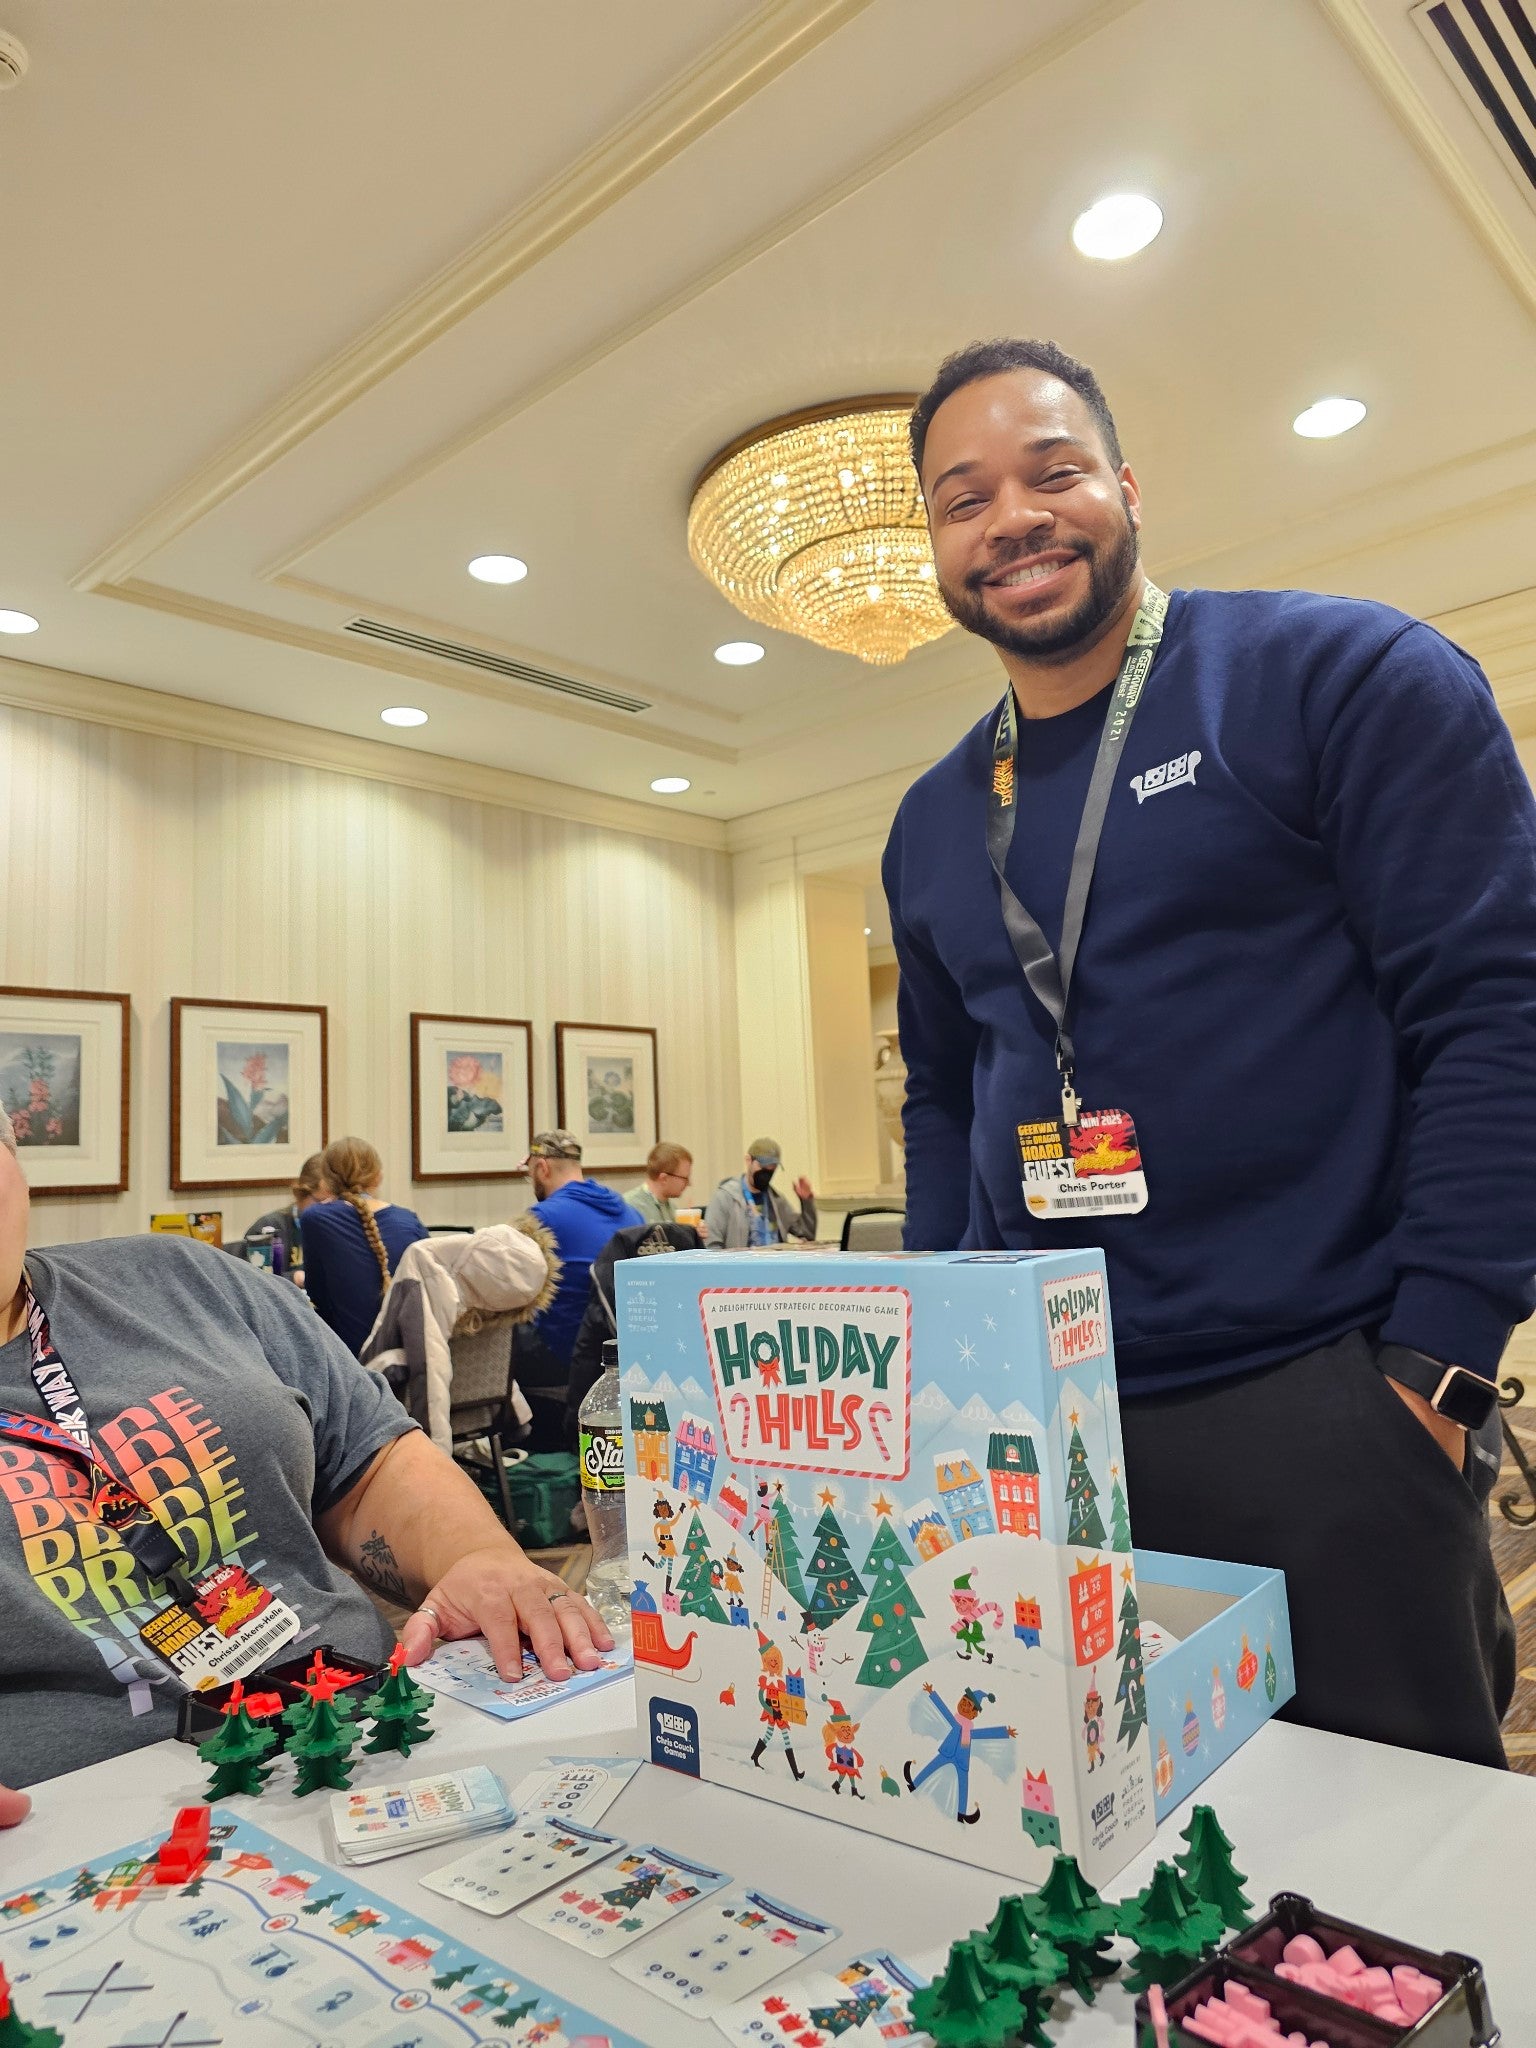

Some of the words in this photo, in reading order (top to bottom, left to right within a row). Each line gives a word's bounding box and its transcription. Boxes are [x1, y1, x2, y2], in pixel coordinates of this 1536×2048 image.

[1117, 673, 1132, 698] West
[1109, 710, 1127, 741] 2021
[1017, 1121, 1058, 1136] GEEKWAY
[1101, 1114, 1122, 1126] 2025
[1021, 1143, 1063, 1162] HOARD
[1024, 1158, 1076, 1181] GUEST
[1060, 1182, 1087, 1193] Chris
[1090, 1180, 1127, 1191] Porter
[711, 1305, 718, 1313] A
[719, 1302, 773, 1313] DELIGHTFULLY
[774, 1302, 816, 1311] STRATEGIC
[818, 1303, 871, 1314] DECORATING
[874, 1305, 900, 1316] GAME
[1047, 1286, 1101, 1329] HOLIDAY
[1062, 1319, 1095, 1356] HILLS
[714, 1319, 901, 1389] HOLIDAY
[755, 1388, 865, 1451] HILLS
[585, 1436, 625, 1474] Sta
[197, 1581, 217, 1597] MINI
[215, 1567, 236, 1584] 2025
[140, 1604, 184, 1638] GEEKWAY
[162, 1613, 192, 1639] DRAGON
[157, 1620, 204, 1657] HOARD
[170, 1624, 226, 1674] GUEST
[208, 1640, 242, 1668] Christal
[240, 1606, 284, 1643] Akers-Helle
[656, 1735, 673, 1747] Chris
[673, 1740, 695, 1754] Couch
[664, 1746, 687, 1759] Games
